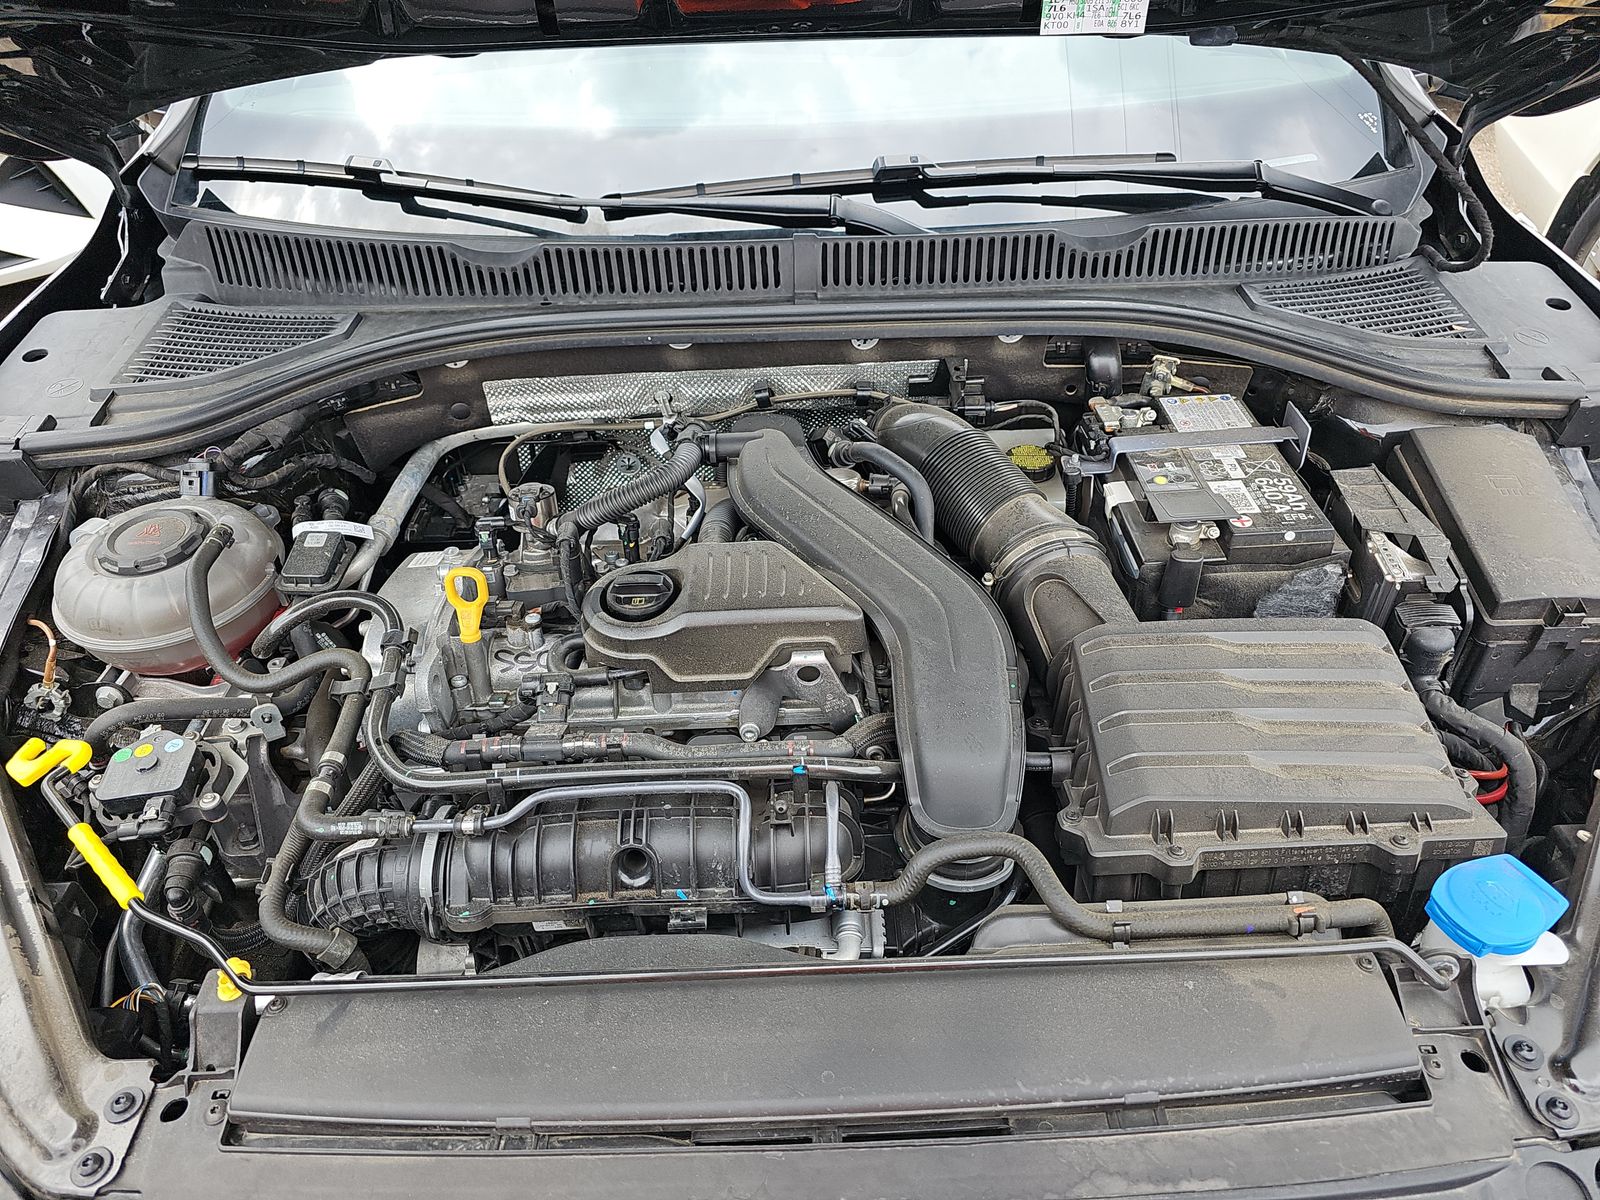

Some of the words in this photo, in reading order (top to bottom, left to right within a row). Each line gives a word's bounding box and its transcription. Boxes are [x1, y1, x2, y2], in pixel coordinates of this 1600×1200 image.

[1122, 12, 1141, 20] 7L6
[1255, 477, 1283, 500] 640
[1270, 502, 1292, 514] A
[1274, 477, 1309, 511] 59Ah
[1283, 511, 1315, 521] EFB+
